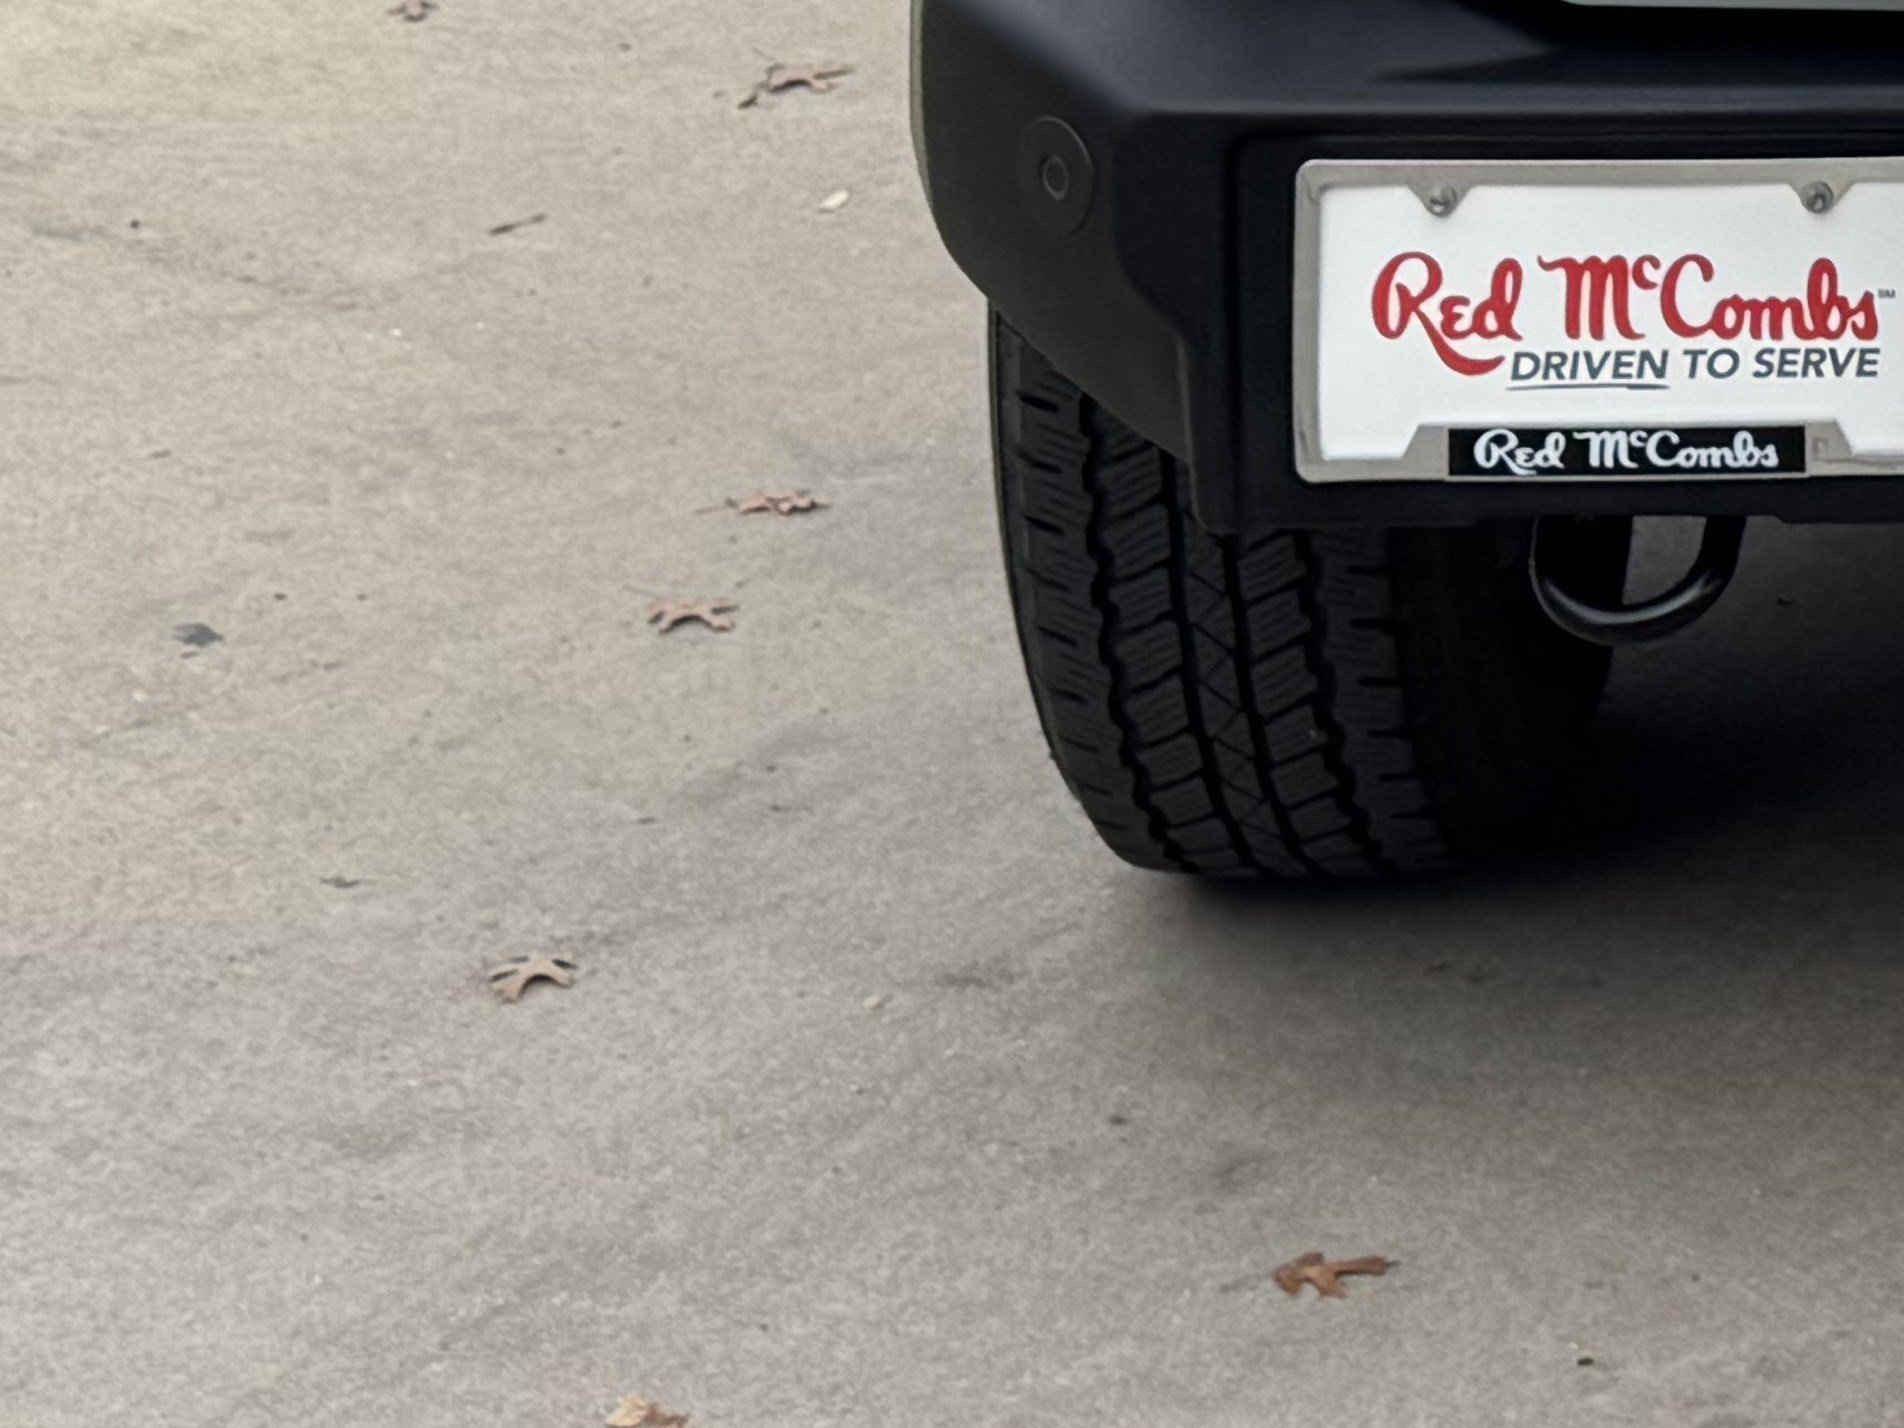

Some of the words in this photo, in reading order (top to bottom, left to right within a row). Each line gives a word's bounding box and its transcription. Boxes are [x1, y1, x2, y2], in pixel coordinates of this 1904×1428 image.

[1371, 251, 1524, 376] Red
[1537, 253, 1879, 341] McCombs
[1510, 349, 1670, 382] DRIVEN
[1684, 348, 1741, 379] TO
[1752, 346, 1881, 379] SERVE
[1473, 429, 1566, 476] Red
[1573, 430, 1780, 469] McCombs
